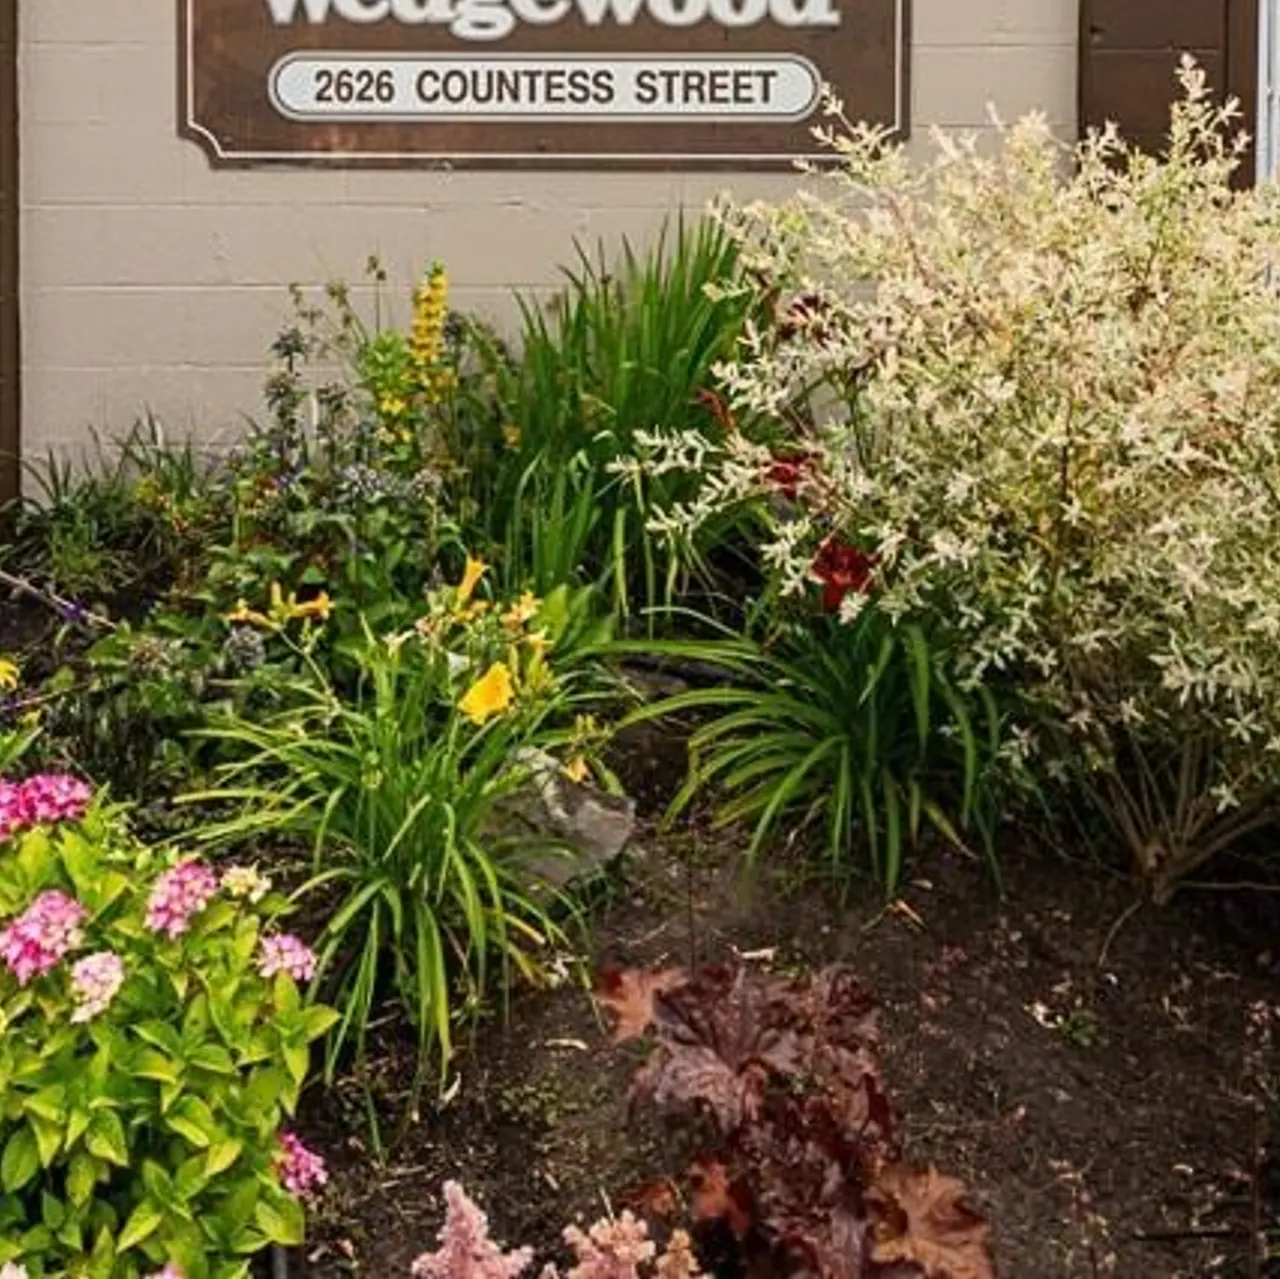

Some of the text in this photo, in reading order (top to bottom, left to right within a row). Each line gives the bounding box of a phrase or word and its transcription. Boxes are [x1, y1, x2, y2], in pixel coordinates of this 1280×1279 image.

[314, 70, 779, 105] 2626 COUNTESS STREET
